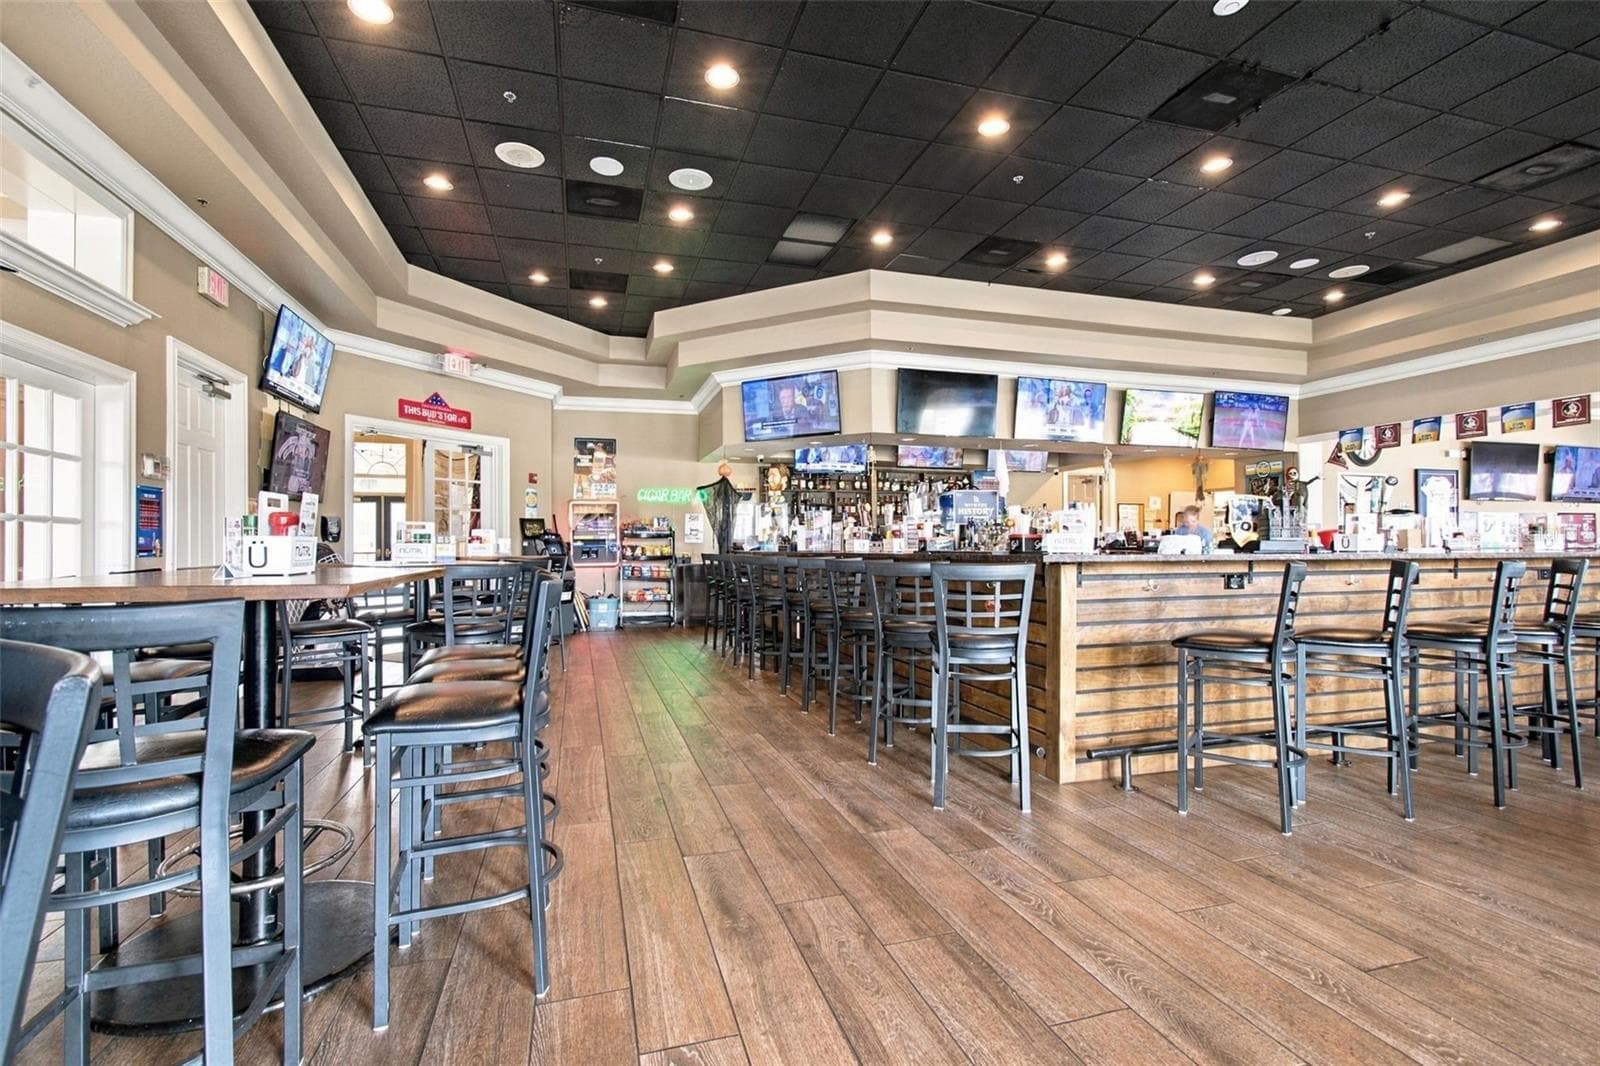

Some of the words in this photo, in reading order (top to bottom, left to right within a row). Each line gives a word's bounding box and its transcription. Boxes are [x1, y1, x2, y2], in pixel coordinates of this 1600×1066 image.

[403, 404, 421, 417] THIS
[421, 407, 443, 420] BUD'S
[443, 412, 458, 423] FOR
[637, 488, 669, 502] CIGAR
[670, 488, 691, 503] BAR
[248, 540, 268, 569] Ü
